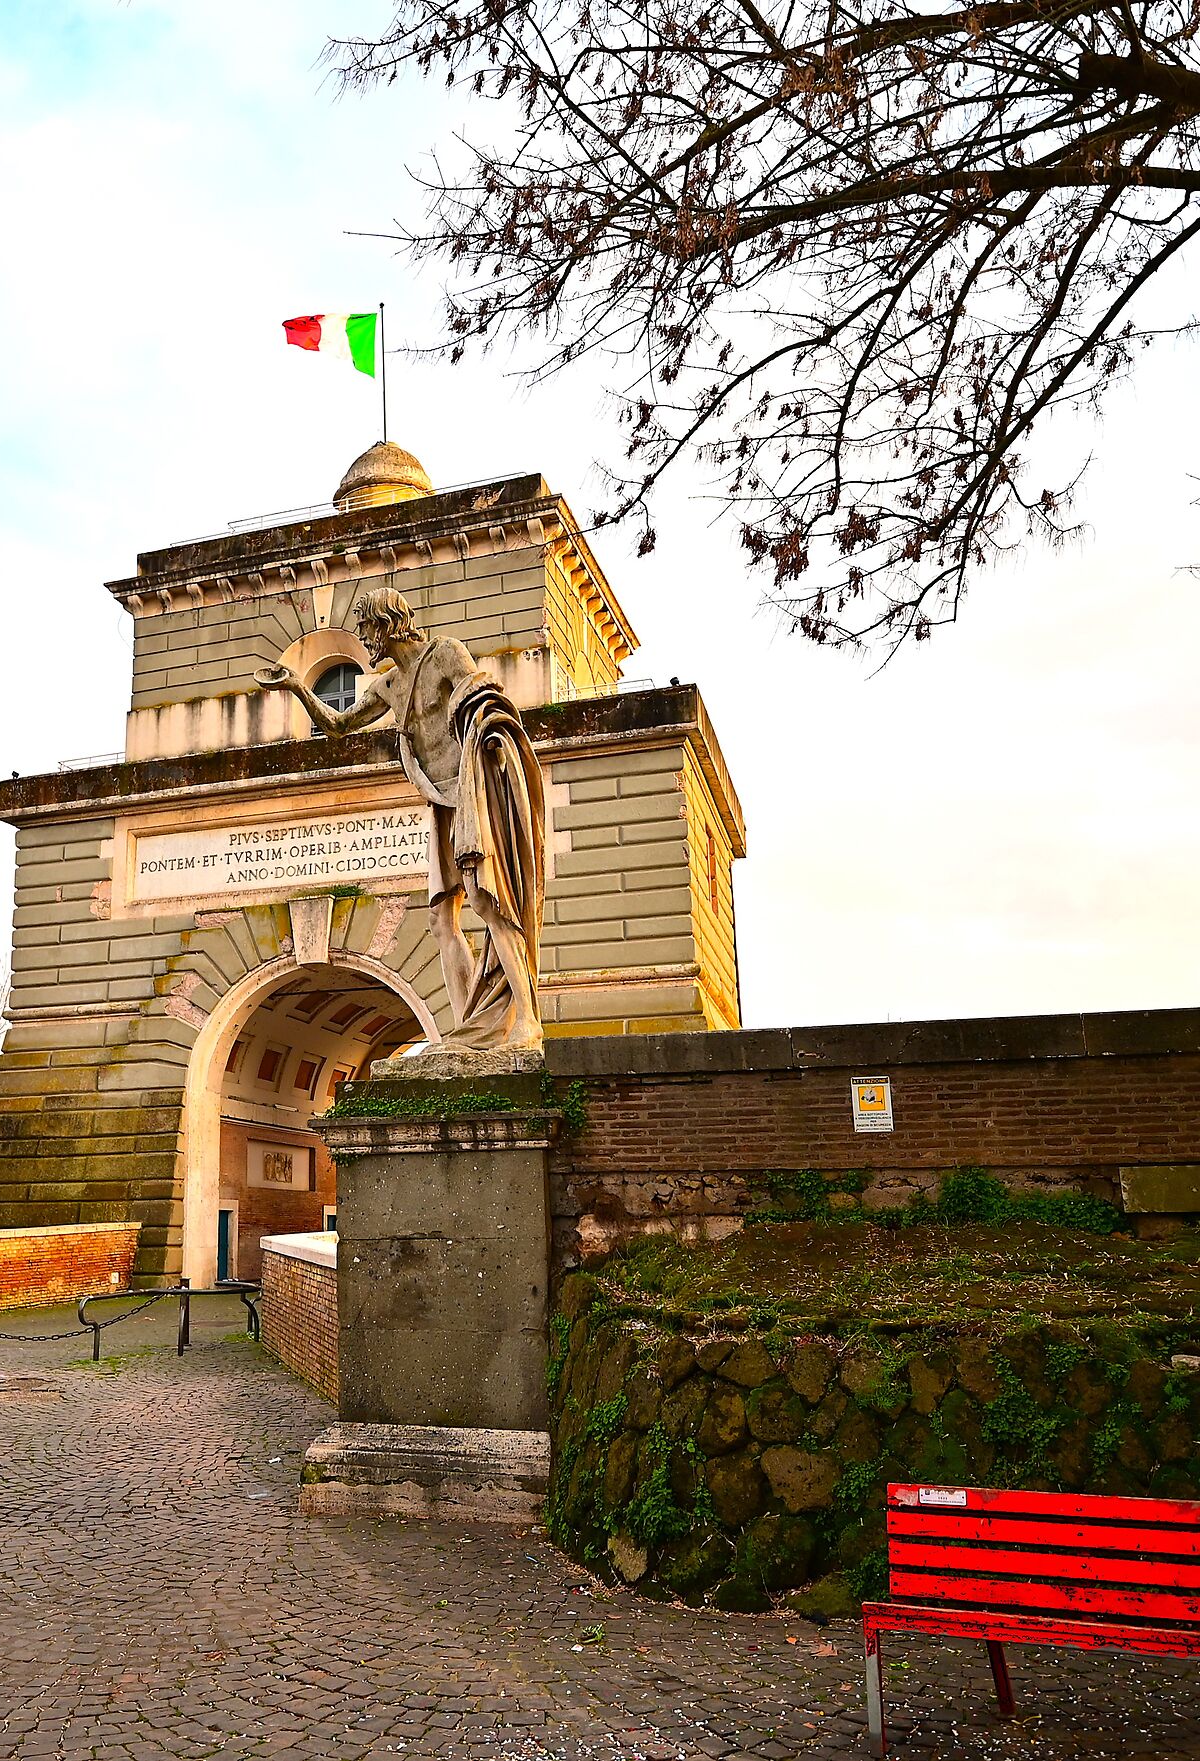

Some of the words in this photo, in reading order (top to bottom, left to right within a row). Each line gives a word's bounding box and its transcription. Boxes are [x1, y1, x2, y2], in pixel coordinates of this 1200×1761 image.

[229, 832, 259, 846] PIVS
[265, 823, 332, 842] SEPTIMVS
[336, 818, 376, 834] PONT
[140, 856, 196, 874] PONTEM
[202, 854, 218, 867] ET
[224, 847, 283, 865] TVRRIM
[226, 867, 269, 883] ANNO
[274, 861, 330, 879] DOMINI
